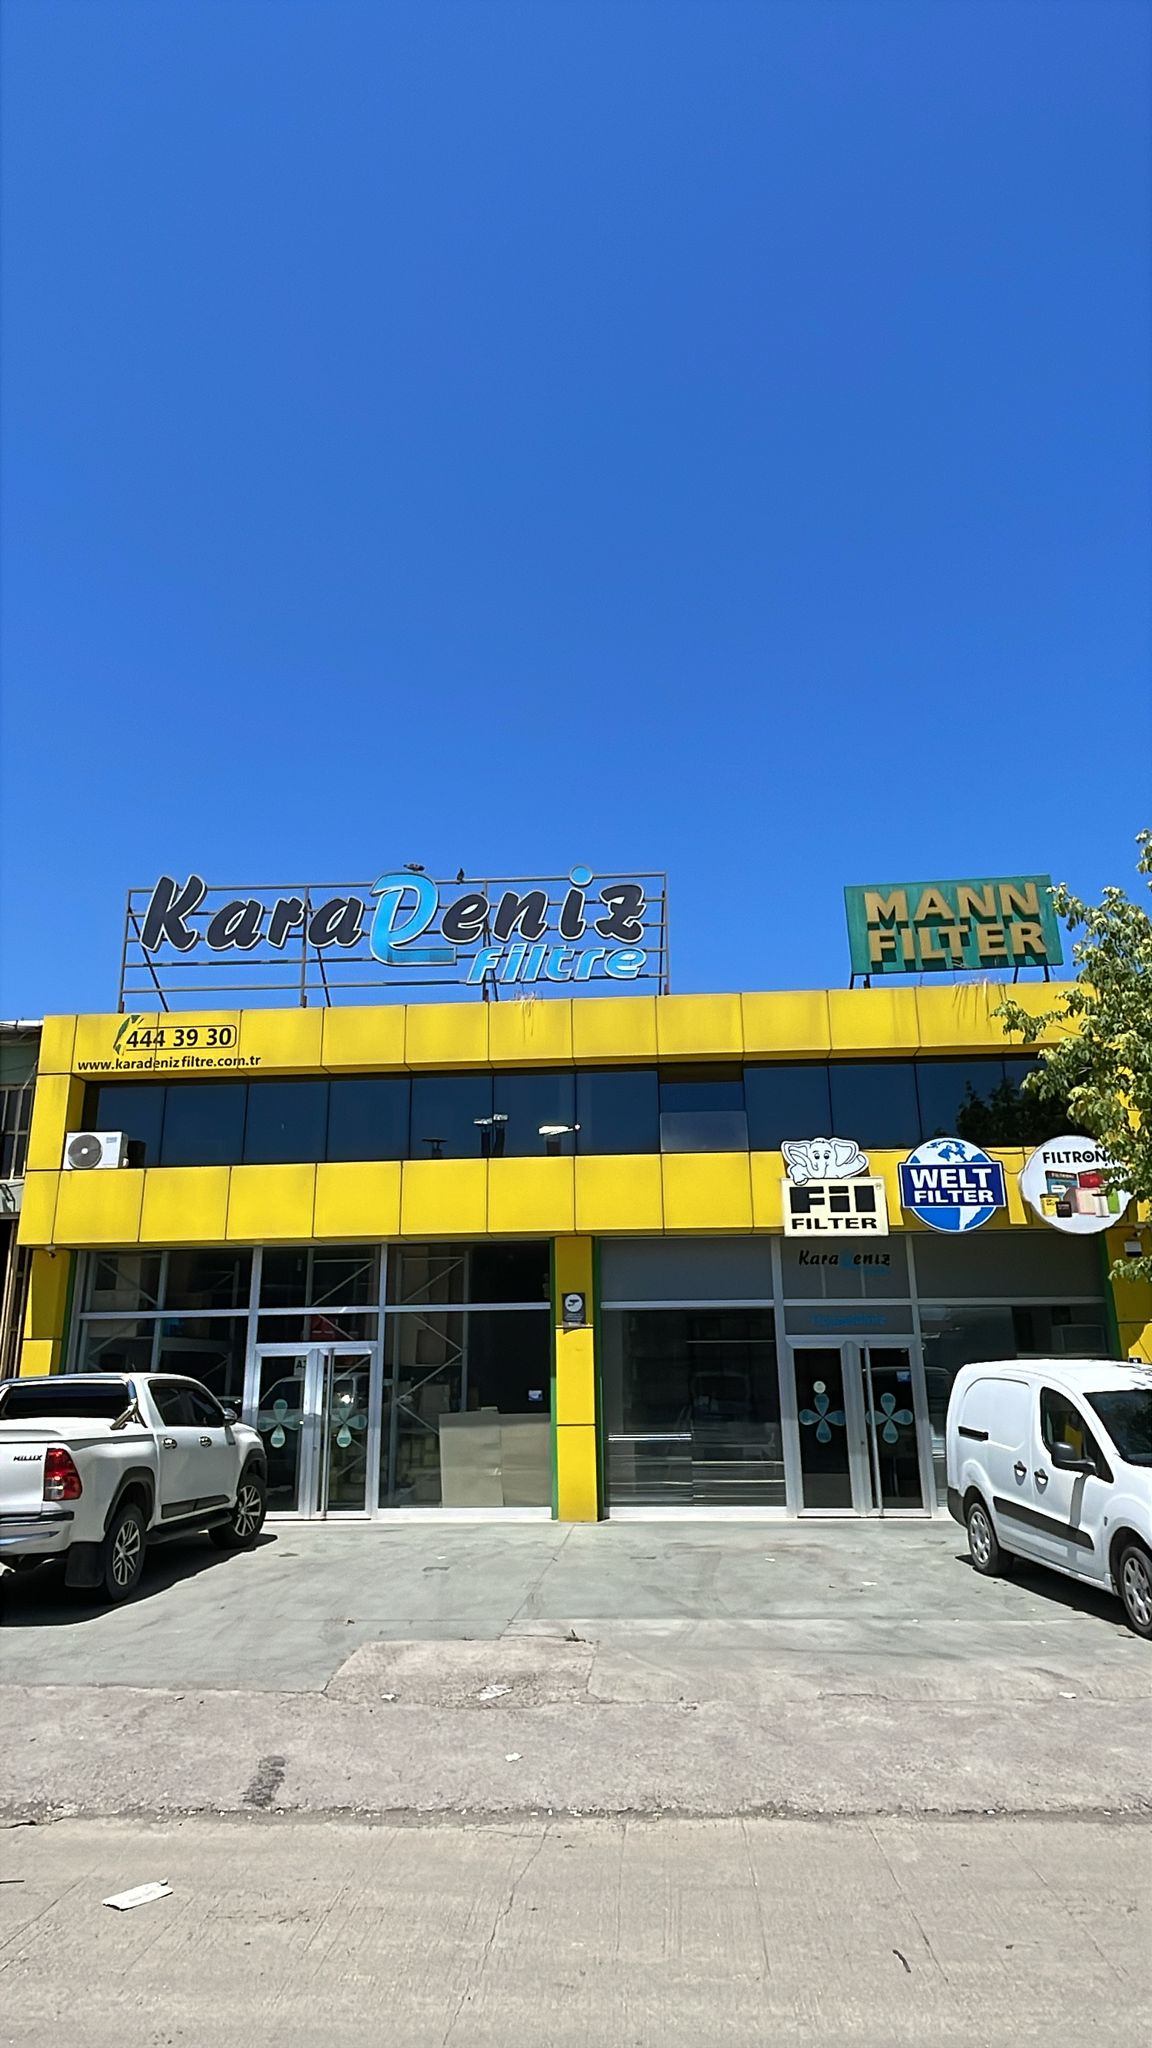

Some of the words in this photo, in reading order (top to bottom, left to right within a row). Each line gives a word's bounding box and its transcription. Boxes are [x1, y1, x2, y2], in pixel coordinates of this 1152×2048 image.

[864, 882, 1040, 922] MANN
[867, 921, 1047, 963] FILTER
[466, 943, 647, 985] filtre
[126, 1030, 166, 1048] 444
[173, 1029, 199, 1047] 39
[206, 1028, 232, 1046] 30
[78, 1055, 261, 1070] www.karadenizfiltre.com.tr
[1042, 1150, 1107, 1164] FILTRON
[910, 1168, 992, 1189] WELT
[914, 1189, 994, 1203] FILTER
[791, 1217, 877, 1230] FILTER
[798, 1248, 891, 1271] Karaeniz
